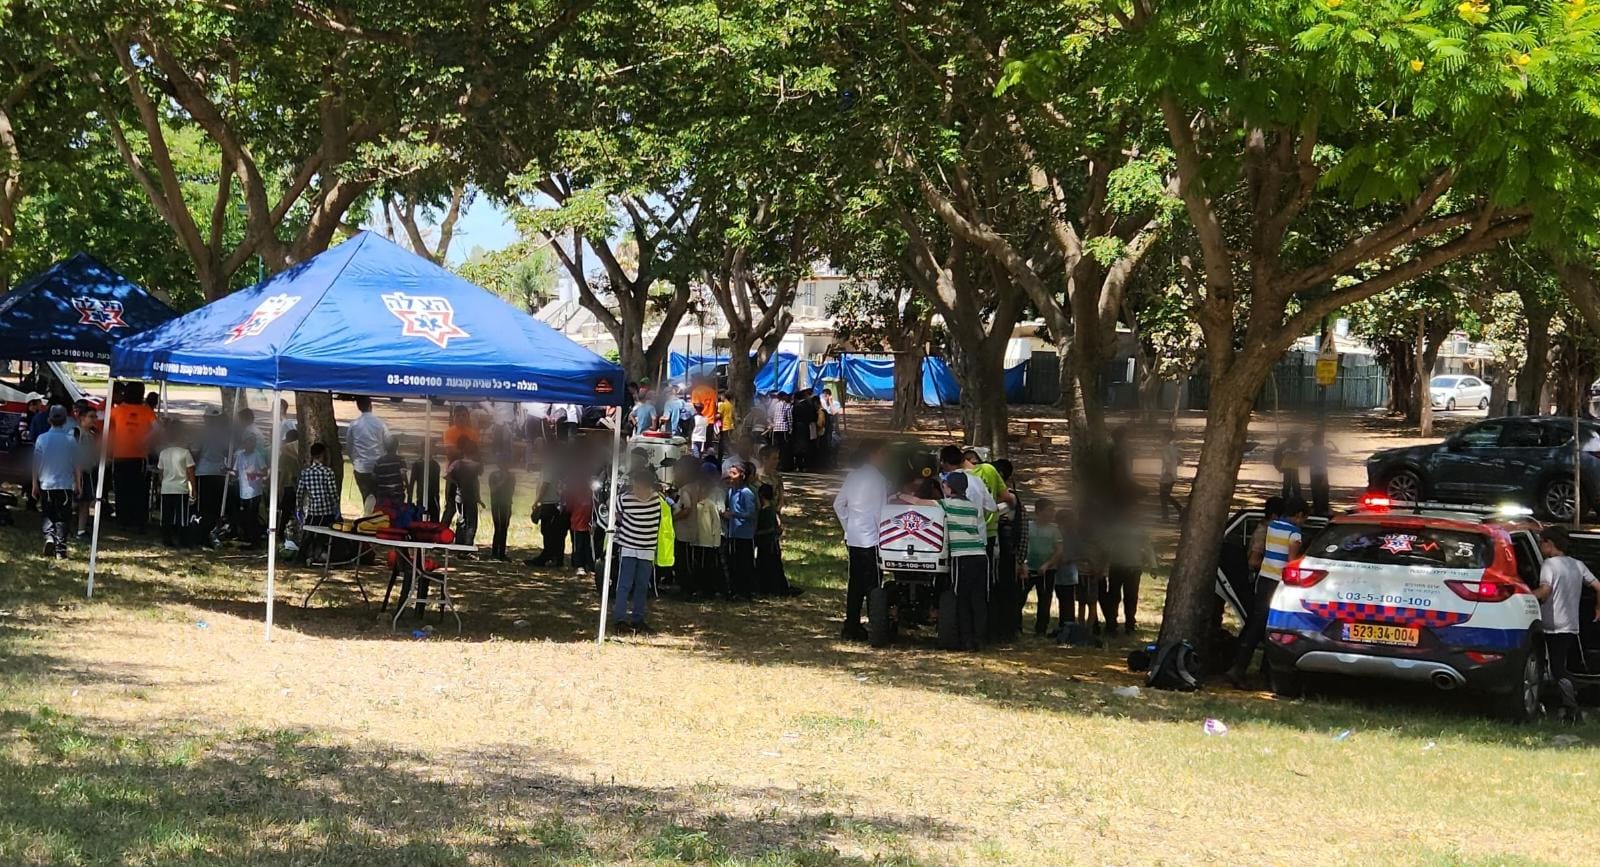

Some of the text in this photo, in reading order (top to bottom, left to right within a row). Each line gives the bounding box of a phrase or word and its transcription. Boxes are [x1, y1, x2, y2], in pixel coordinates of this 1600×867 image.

[387, 374, 442, 387] 03-5100100
[492, 378, 502, 389] כל
[503, 381, 511, 389] כי
[517, 380, 538, 391] הצלה
[1346, 592, 1431, 607] 03-5-100-100
